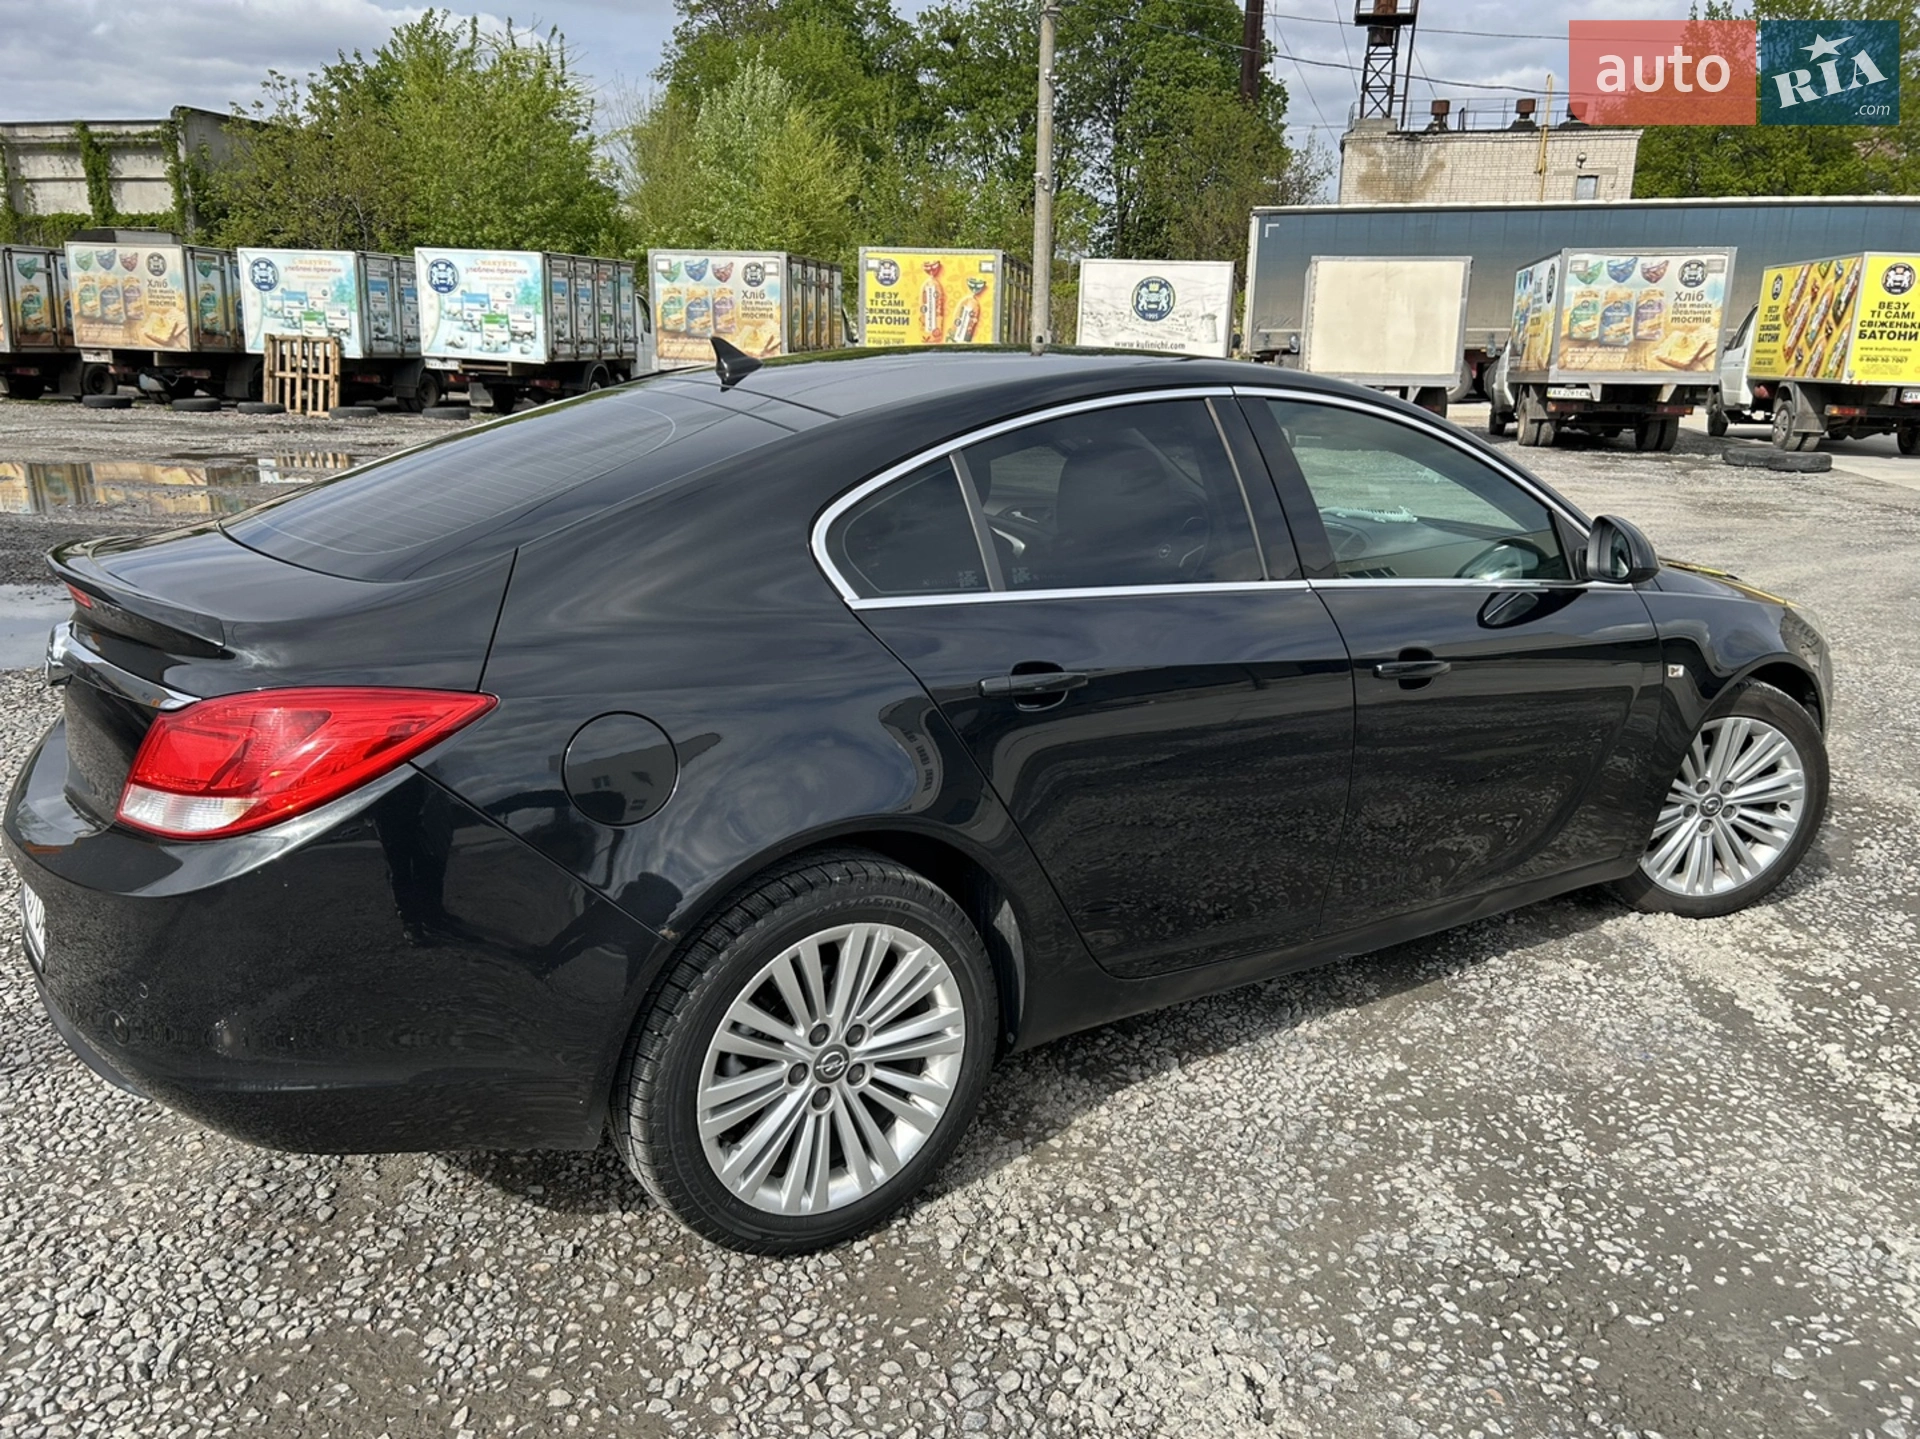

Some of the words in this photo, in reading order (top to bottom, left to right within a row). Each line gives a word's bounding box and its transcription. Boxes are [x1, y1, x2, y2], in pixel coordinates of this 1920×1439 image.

[147, 279, 168, 288] Хліб
[741, 290, 766, 300] Хліб
[874, 292, 899, 300] ВЕЗУ
[1674, 291, 1705, 302] Хліб
[1878, 301, 1910, 310] ВЕЗУ
[742, 311, 774, 320] тостів
[1671, 308, 1712, 316] ідеальних
[1870, 310, 1881, 318] ТІ
[1884, 311, 1915, 319] САМІ
[1671, 315, 1711, 324] тостів
[1858, 330, 1919, 341] БАТОНИ
